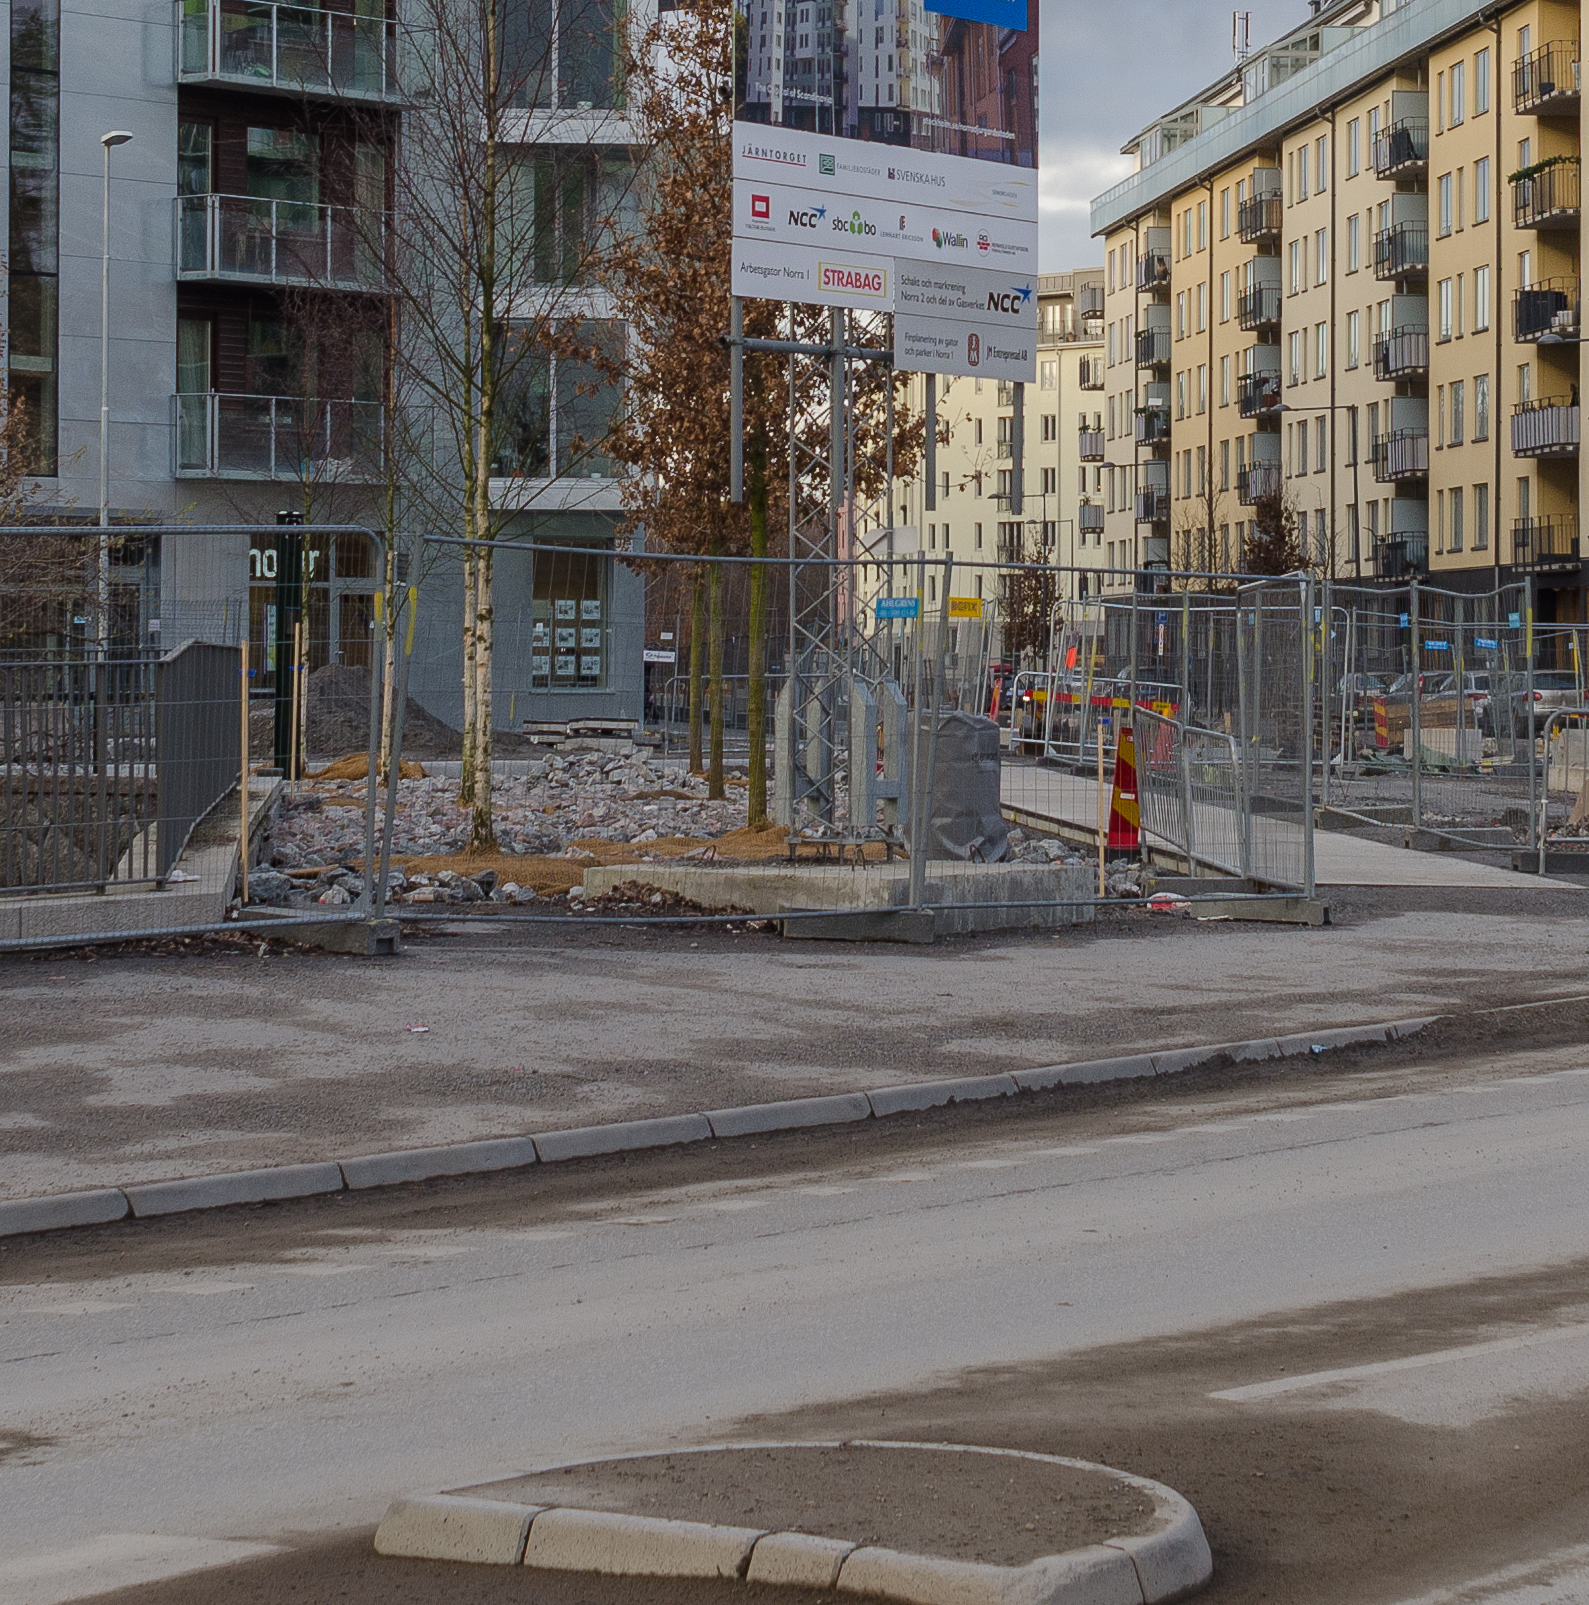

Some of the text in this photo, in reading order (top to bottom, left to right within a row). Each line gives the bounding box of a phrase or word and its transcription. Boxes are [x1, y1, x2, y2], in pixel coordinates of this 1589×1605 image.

[741, 143, 807, 164] JÄRNTORGET
[896, 168, 946, 187] SVENSKA HUS
[788, 210, 818, 229] NCC
[823, 268, 882, 291] STRABAG
[901, 291, 919, 302] Norra
[925, 294, 937, 304] och
[938, 295, 947, 306] del
[986, 291, 1021, 314] NCC
